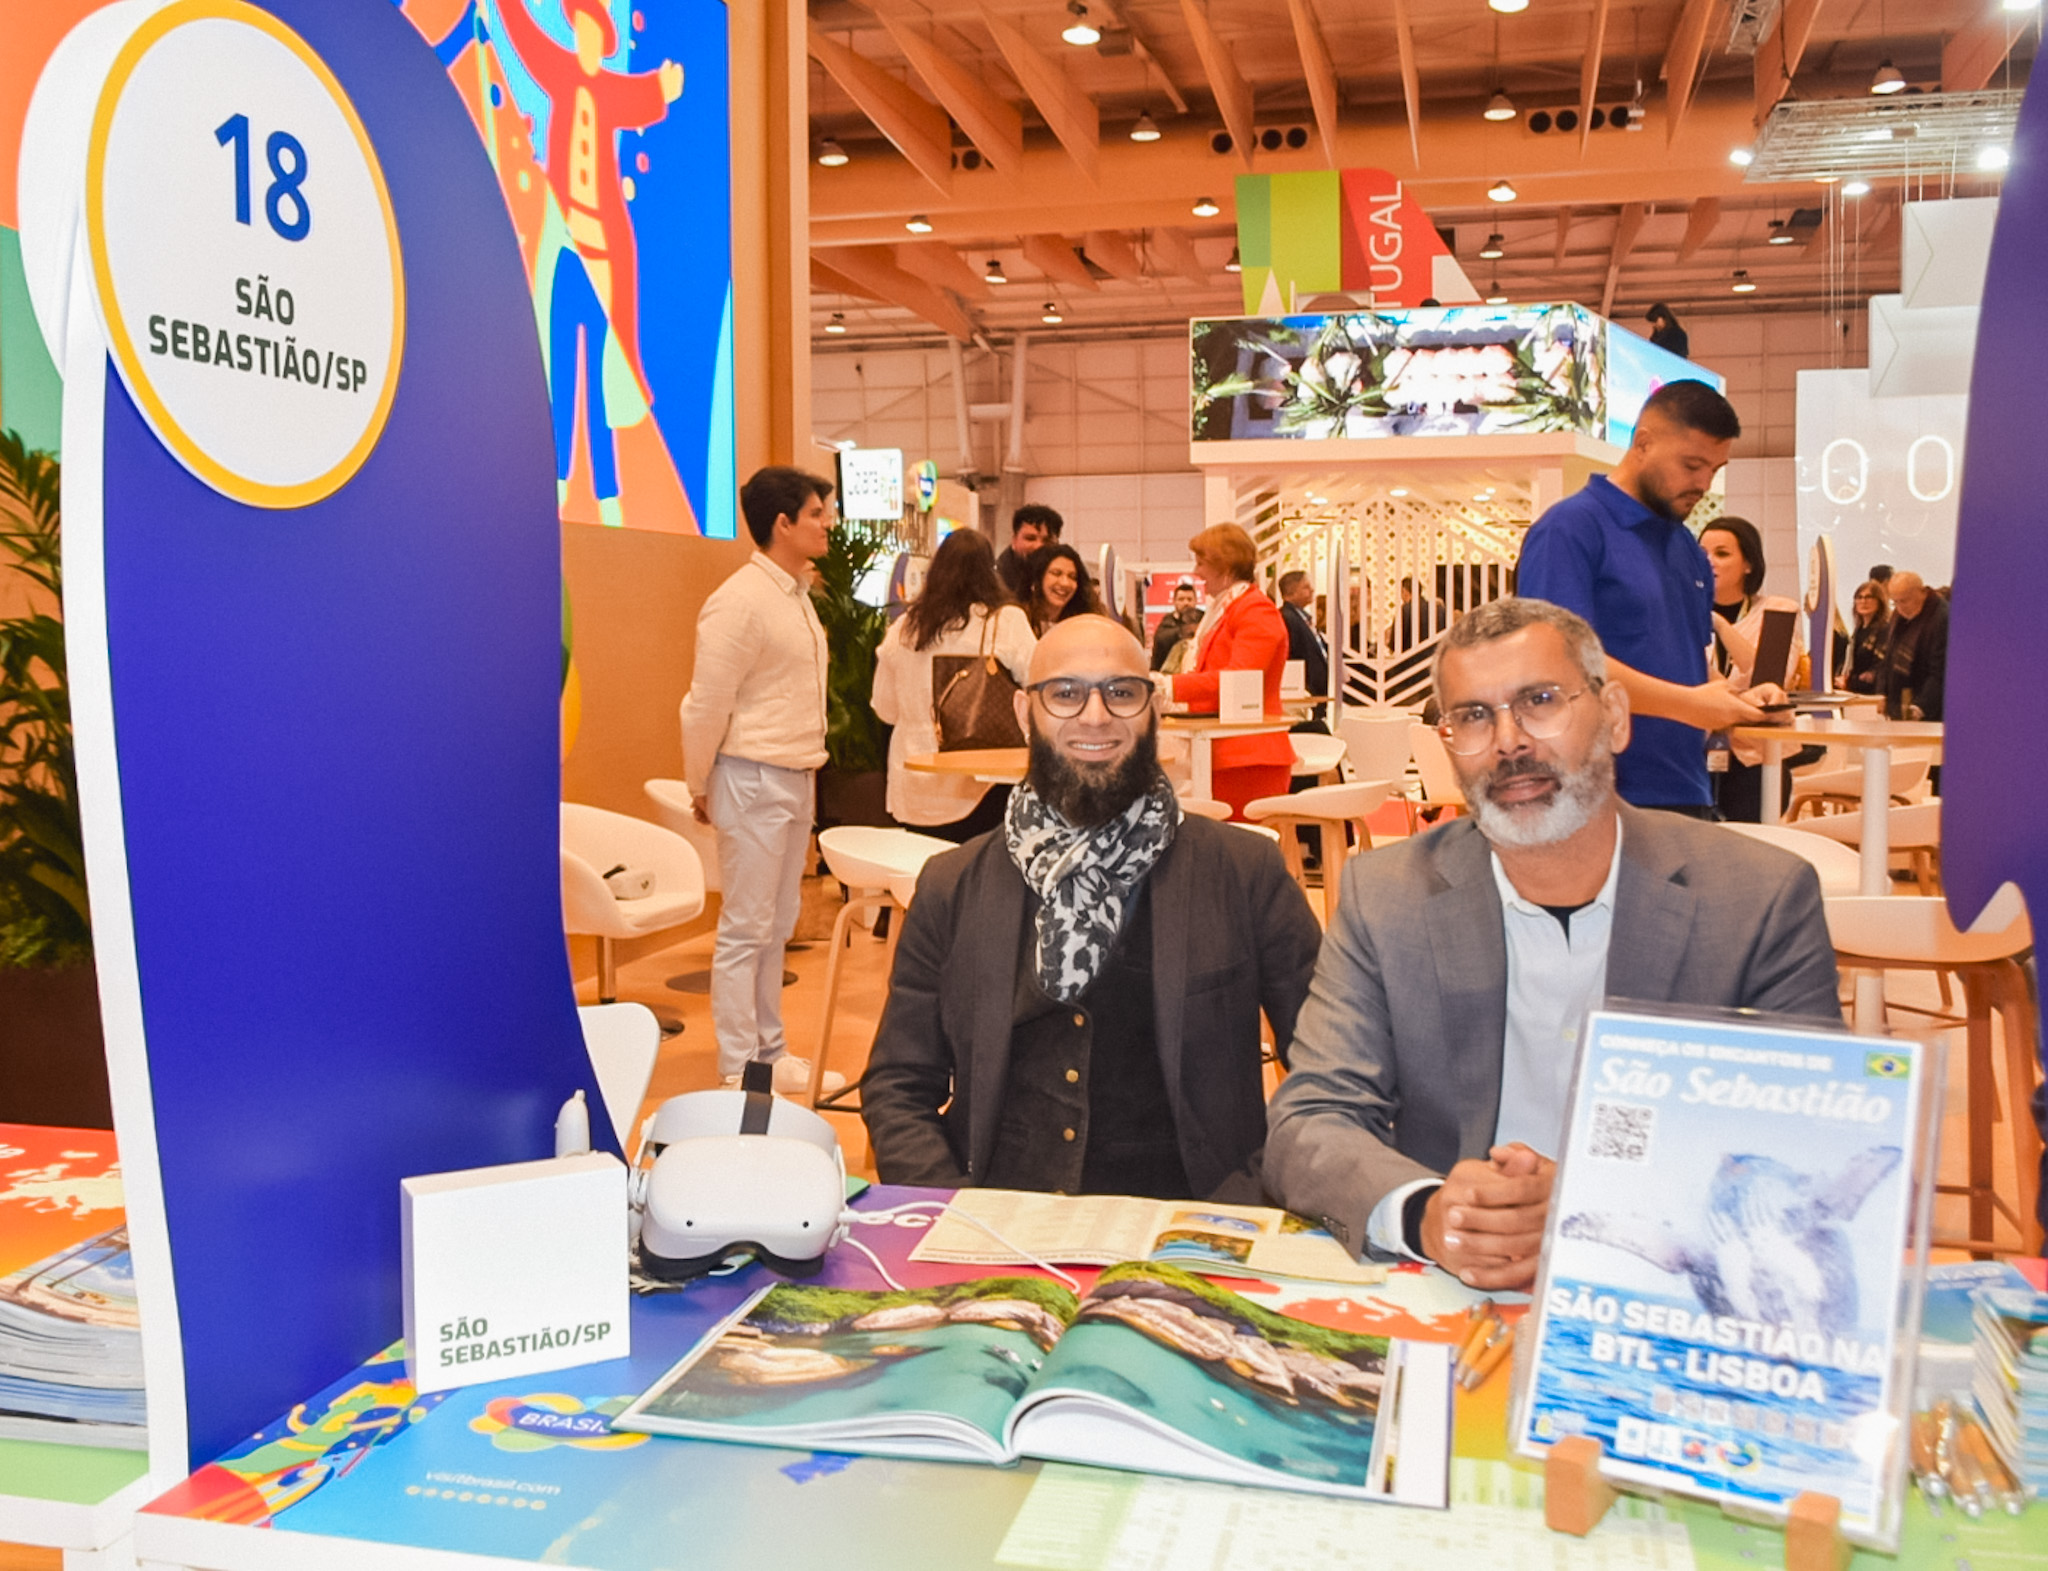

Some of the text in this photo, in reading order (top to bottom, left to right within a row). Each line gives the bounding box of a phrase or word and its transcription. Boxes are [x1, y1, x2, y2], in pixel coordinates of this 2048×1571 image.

[213, 113, 311, 242] 18
[235, 273, 295, 326] SÃO
[149, 314, 367, 393] SEBASTIÃO/SP
[1593, 1057, 1892, 1123] São Sebastião
[439, 1316, 488, 1343] SÃO
[440, 1321, 612, 1367] SEBASTIÃO/SP
[1549, 1286, 1883, 1374] SÃO SEBASTIÃO NA
[1591, 1331, 1658, 1372] BTL
[1686, 1349, 1826, 1402] LISBOA
